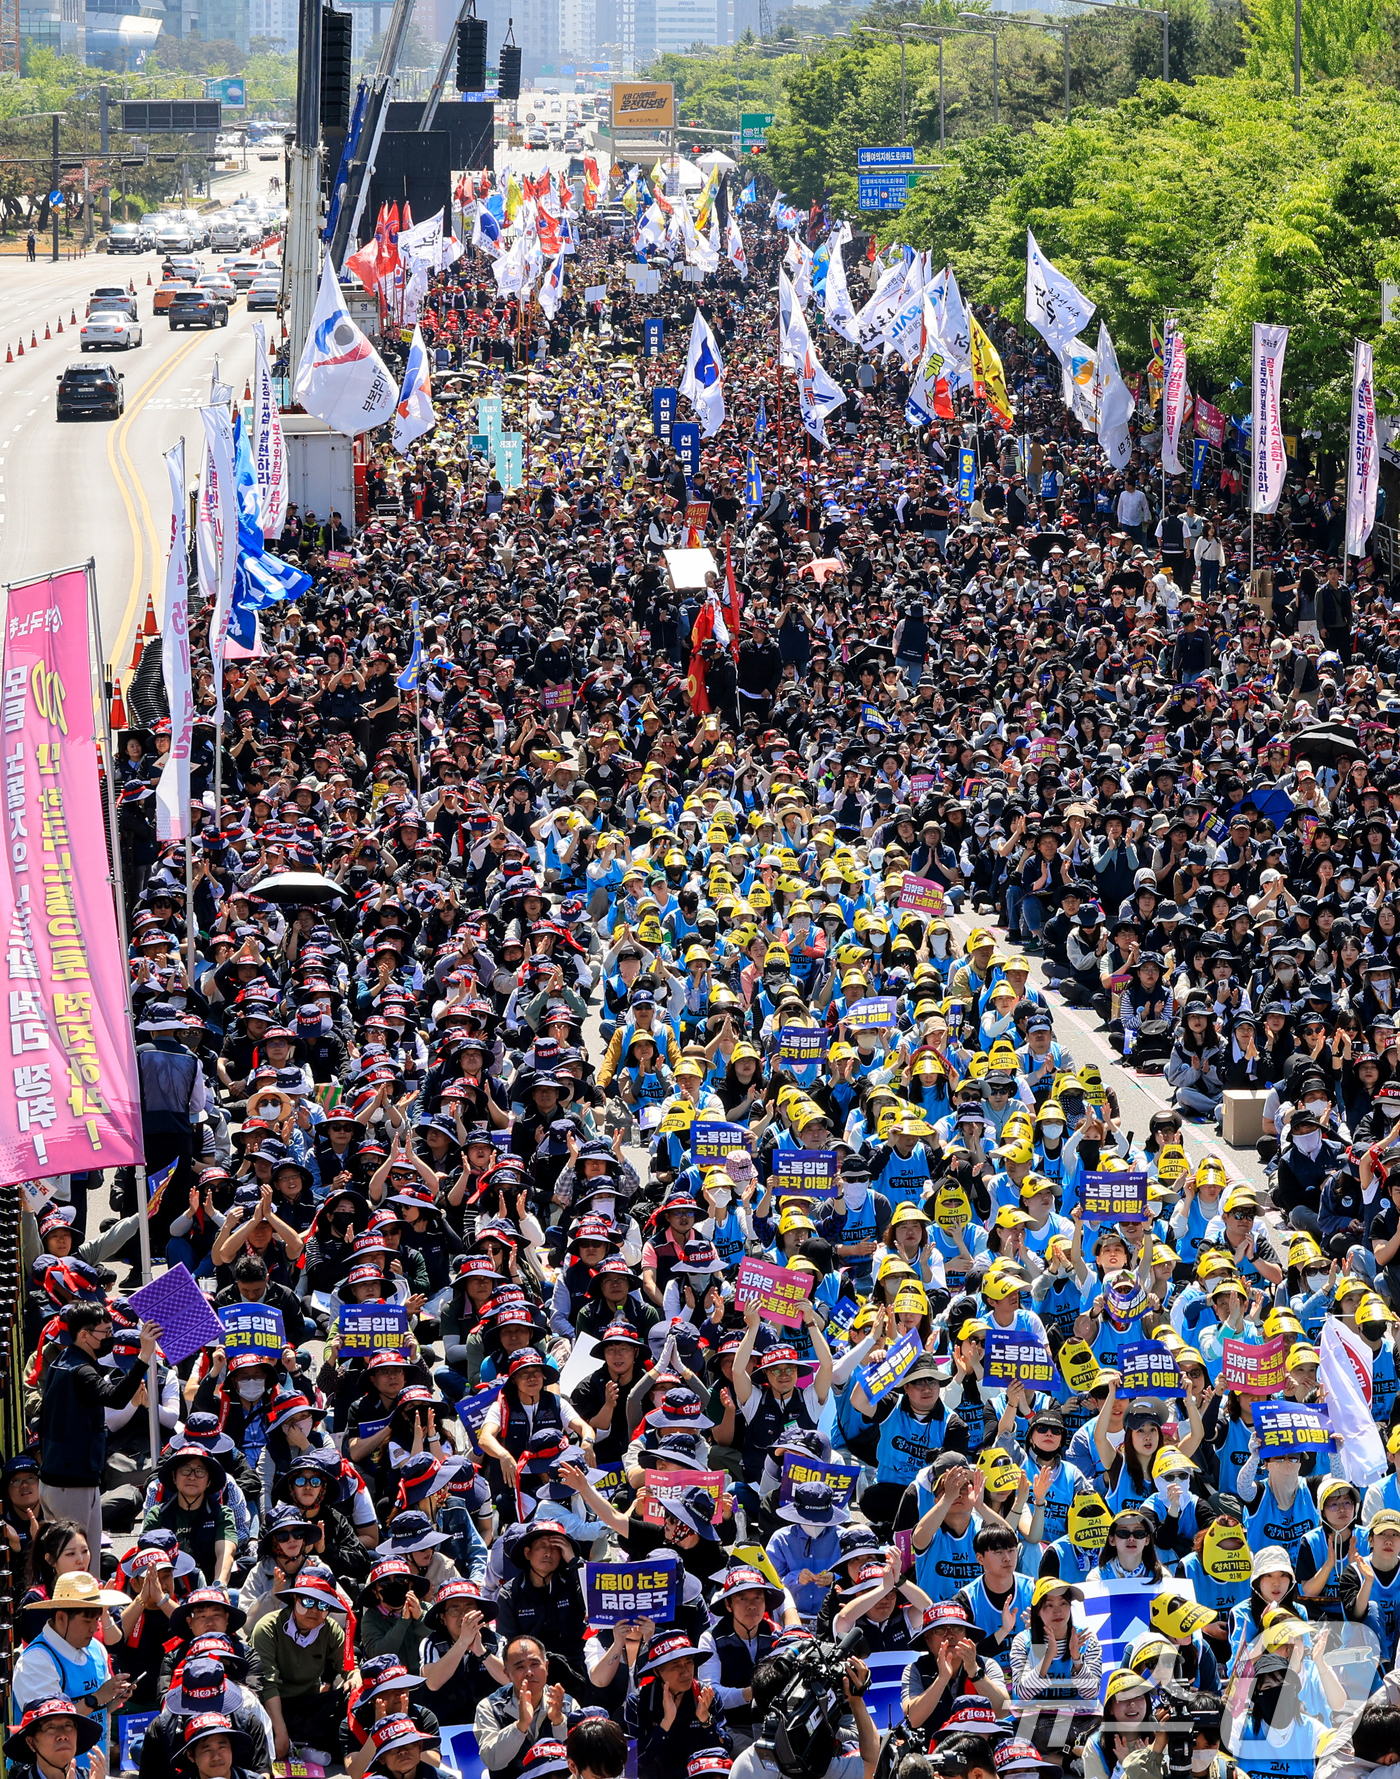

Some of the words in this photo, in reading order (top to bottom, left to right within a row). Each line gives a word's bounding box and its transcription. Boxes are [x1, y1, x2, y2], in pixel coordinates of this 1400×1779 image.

[633, 91, 657, 100] 다이렉트
[621, 97, 667, 111] 운전자보험
[1271, 440, 1283, 474] 실현!
[1356, 413, 1367, 494] 중단하라!
[257, 430, 271, 501] 실현하라!
[1258, 450, 1269, 504] 설치하라!
[904, 884, 923, 895] 되찾은
[902, 894, 914, 903] 다시
[849, 1003, 888, 1016] 노동입법
[849, 1015, 866, 1025] 즉각
[868, 1012, 892, 1023] 이행!
[781, 1035, 820, 1048] 노동입법
[779, 1047, 799, 1058] 즉각
[801, 1048, 822, 1059] 이행!
[696, 1131, 742, 1144] 노동입법
[696, 1144, 719, 1156] 즉각
[778, 1162, 828, 1175] 노동입법
[778, 1176, 802, 1189] 즉각
[804, 1177, 832, 1190] 이행!
[891, 1177, 926, 1187] 정치기본권
[1085, 1183, 1138, 1198] 노동입법
[1085, 1199, 1111, 1213] 즉각
[1112, 1200, 1143, 1213] 이행!
[841, 1228, 876, 1240] 정치기본권
[741, 1271, 774, 1293] 되찾은
[773, 1281, 806, 1300] 노동절
[760, 1293, 800, 1319] 노동중심!
[224, 1315, 277, 1333] 노동입법
[344, 1317, 399, 1332] 노동입법
[224, 1333, 251, 1347] 즉각
[255, 1333, 282, 1349] 이행!
[344, 1333, 371, 1348] 즉각
[373, 1333, 404, 1348] 이행!
[990, 1343, 1048, 1363] 노동입법
[1226, 1352, 1258, 1371] 되찾은
[1259, 1350, 1284, 1371] 노동절
[866, 1342, 913, 1385] 노동입법
[989, 1361, 1018, 1379] 즉각
[1022, 1363, 1053, 1381] 이행!
[1079, 1363, 1092, 1371] 교사
[1123, 1354, 1173, 1373] 노동입법
[869, 1373, 895, 1395] 즉각
[1122, 1373, 1148, 1389] 즉각
[1151, 1371, 1179, 1388] 이행!
[1225, 1367, 1245, 1385] 다시
[1247, 1368, 1286, 1386] 노동중심!
[1261, 1412, 1321, 1430] 노동입법
[1263, 1430, 1294, 1446] 즉각
[1296, 1428, 1329, 1445] 이행!
[824, 1473, 852, 1489] 즉각
[1281, 1517, 1295, 1525] 교사
[1267, 1522, 1312, 1539] 정치기본권
[952, 1552, 969, 1561] 교사
[1214, 1562, 1250, 1571] 정치기본권
[595, 1573, 633, 1591] 이행!
[638, 1571, 669, 1590] 즉각
[1228, 1572, 1242, 1580] 회복
[601, 1591, 669, 1610] 노동입법
[1182, 1603, 1194, 1613] 교사
[1216, 1596, 1235, 1606] 교사
[84, 1681, 98, 1690] 교사
[1270, 1762, 1290, 1772] 교사
